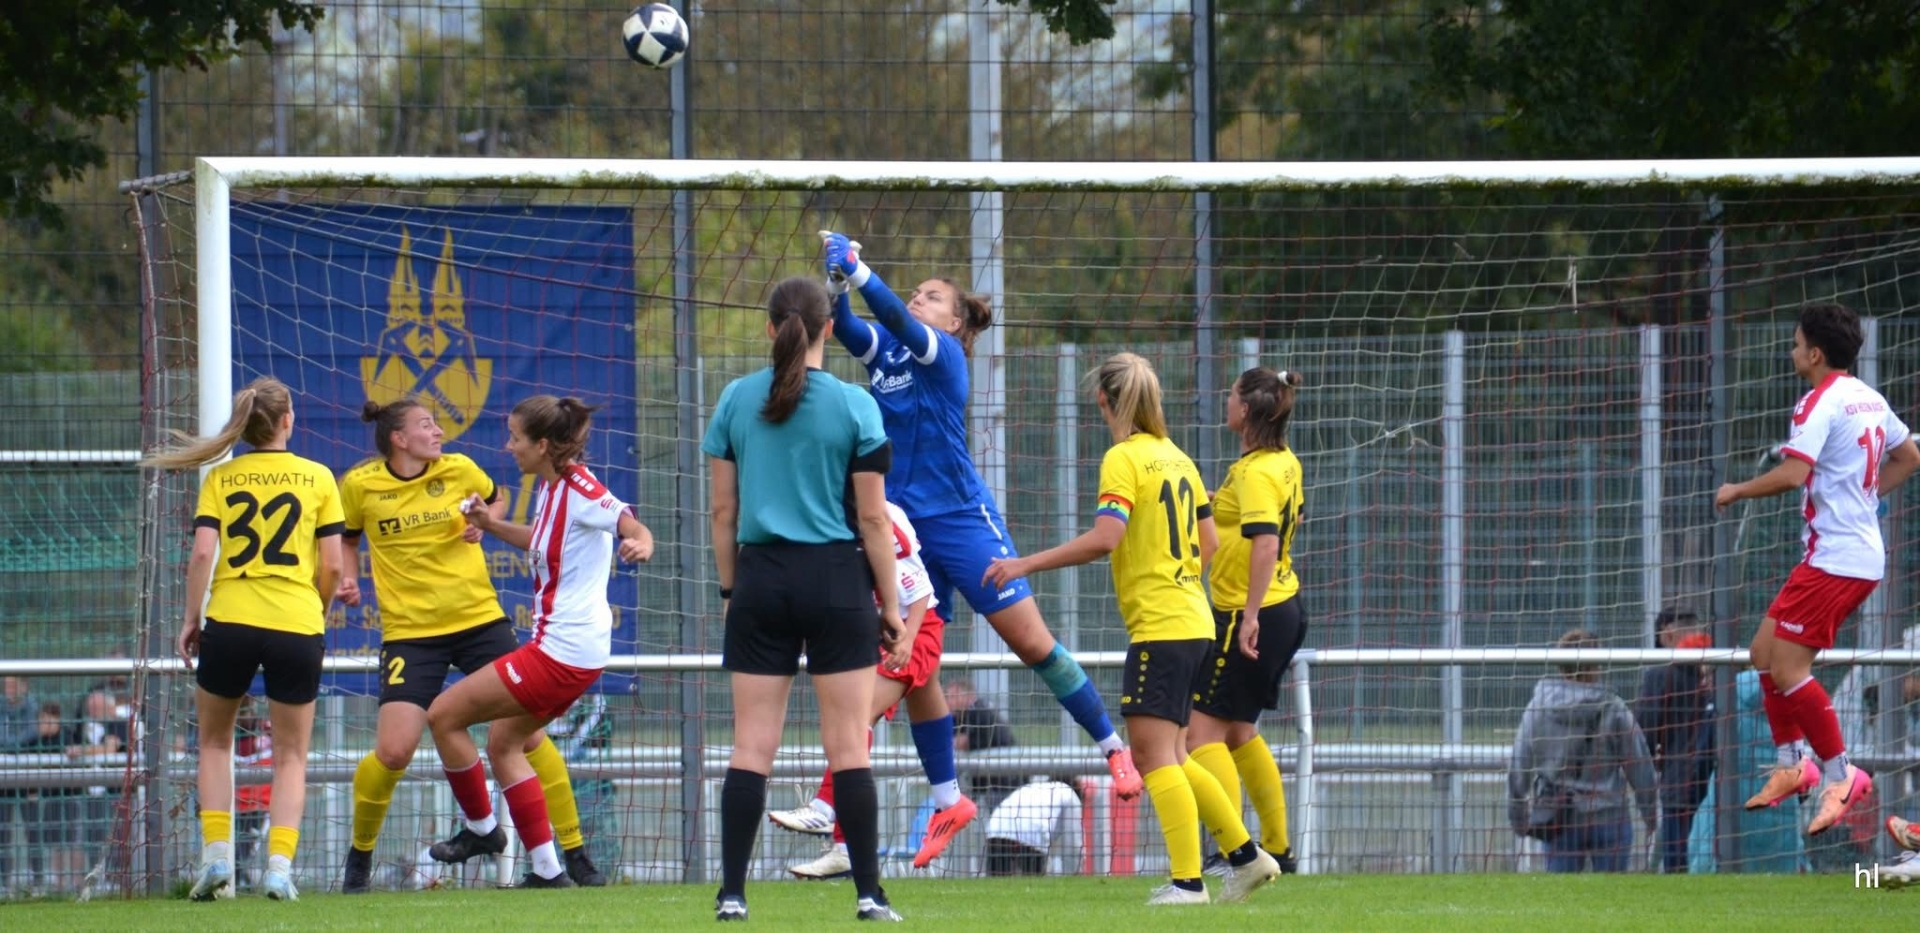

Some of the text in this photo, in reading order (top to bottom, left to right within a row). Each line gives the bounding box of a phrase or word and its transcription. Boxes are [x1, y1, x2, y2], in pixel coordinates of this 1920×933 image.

[221, 472, 315, 489] HORWATH
[379, 493, 398, 501] JAKO
[1107, 499, 1119, 512] C
[403, 514, 420, 527] VR
[422, 507, 452, 523] Bank
[1158, 476, 1200, 560] 12
[225, 490, 303, 569] 32
[998, 588, 1016, 601] JAKO
[388, 657, 406, 685] 2
